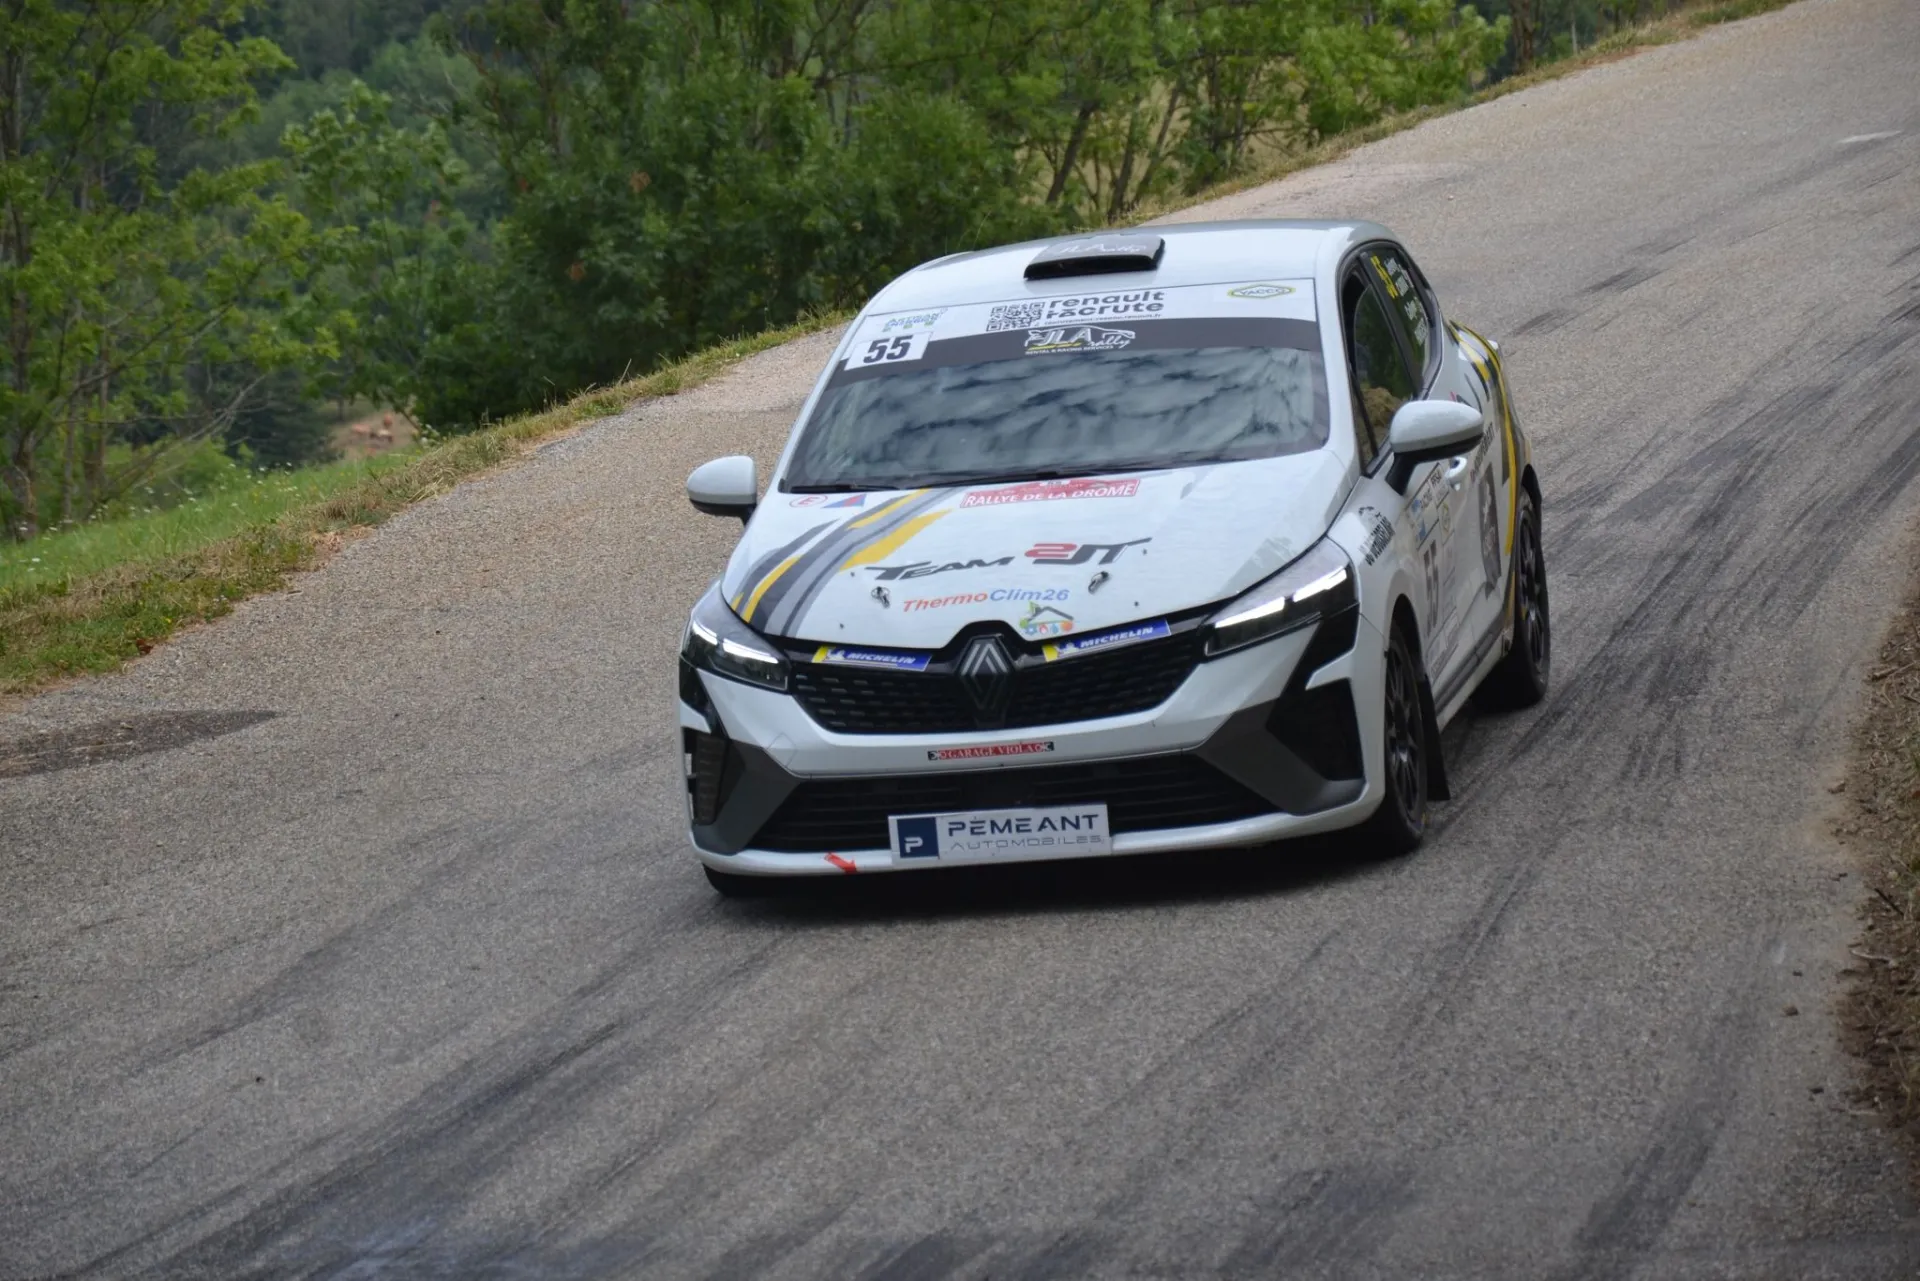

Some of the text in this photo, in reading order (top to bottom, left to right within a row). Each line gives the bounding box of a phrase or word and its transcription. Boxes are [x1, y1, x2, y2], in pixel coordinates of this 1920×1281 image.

[1049, 291, 1165, 309] renault
[1034, 327, 1131, 349] JLA rally
[863, 335, 914, 364] 55
[965, 494, 1018, 506] RALLYE
[1022, 492, 1044, 501] DE
[1049, 491, 1067, 499] LA
[1072, 483, 1135, 498] DROME
[865, 556, 1016, 581] TEAM
[903, 588, 1070, 612] ThermoClim26
[1080, 626, 1154, 648] MICHELIN
[846, 651, 917, 664] MICHELIN
[948, 746, 993, 759] GARAGE
[904, 836, 924, 854] P
[950, 834, 1102, 851] AUTOMOBILES
